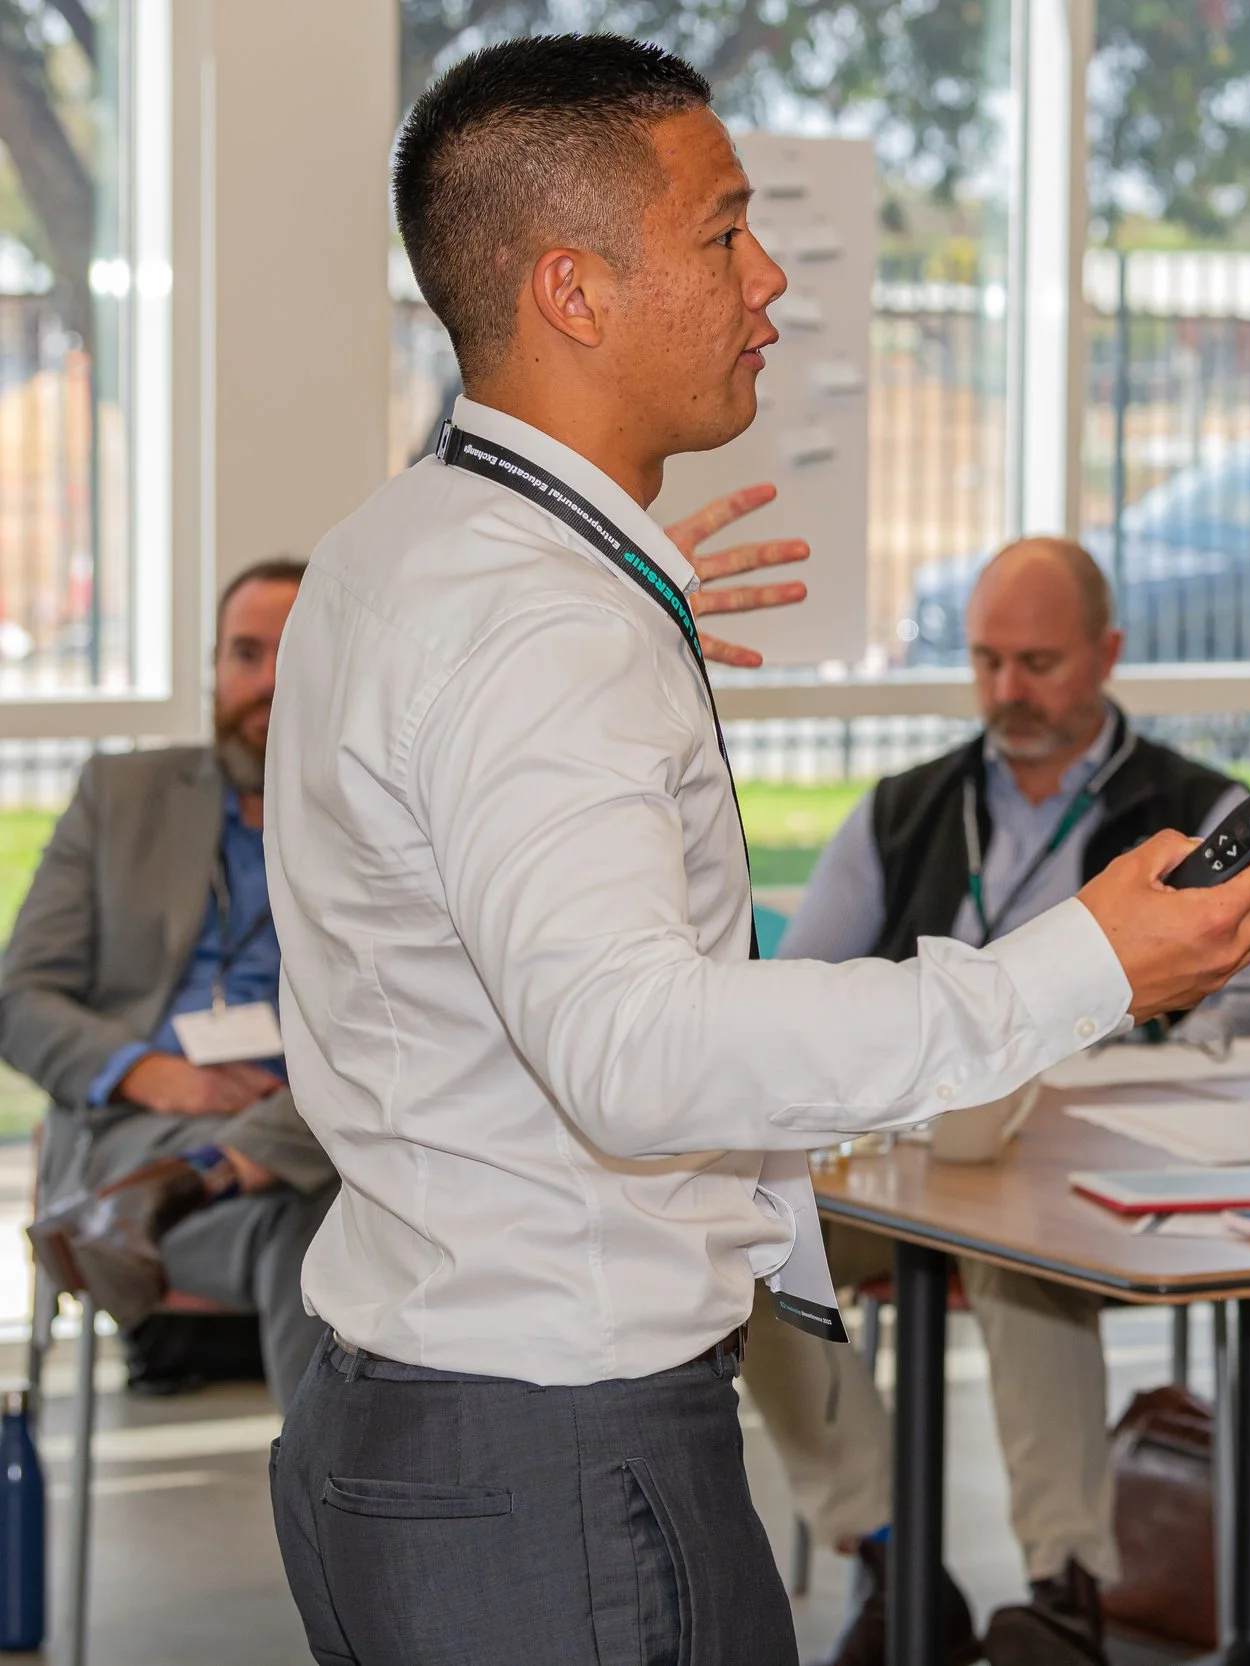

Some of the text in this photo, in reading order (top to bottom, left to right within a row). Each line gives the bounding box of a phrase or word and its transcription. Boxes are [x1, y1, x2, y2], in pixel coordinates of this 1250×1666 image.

[498, 459, 549, 492] Education
[548, 488, 621, 550] Entrepreneurial
[624, 552, 694, 637] LEADERSHIP
